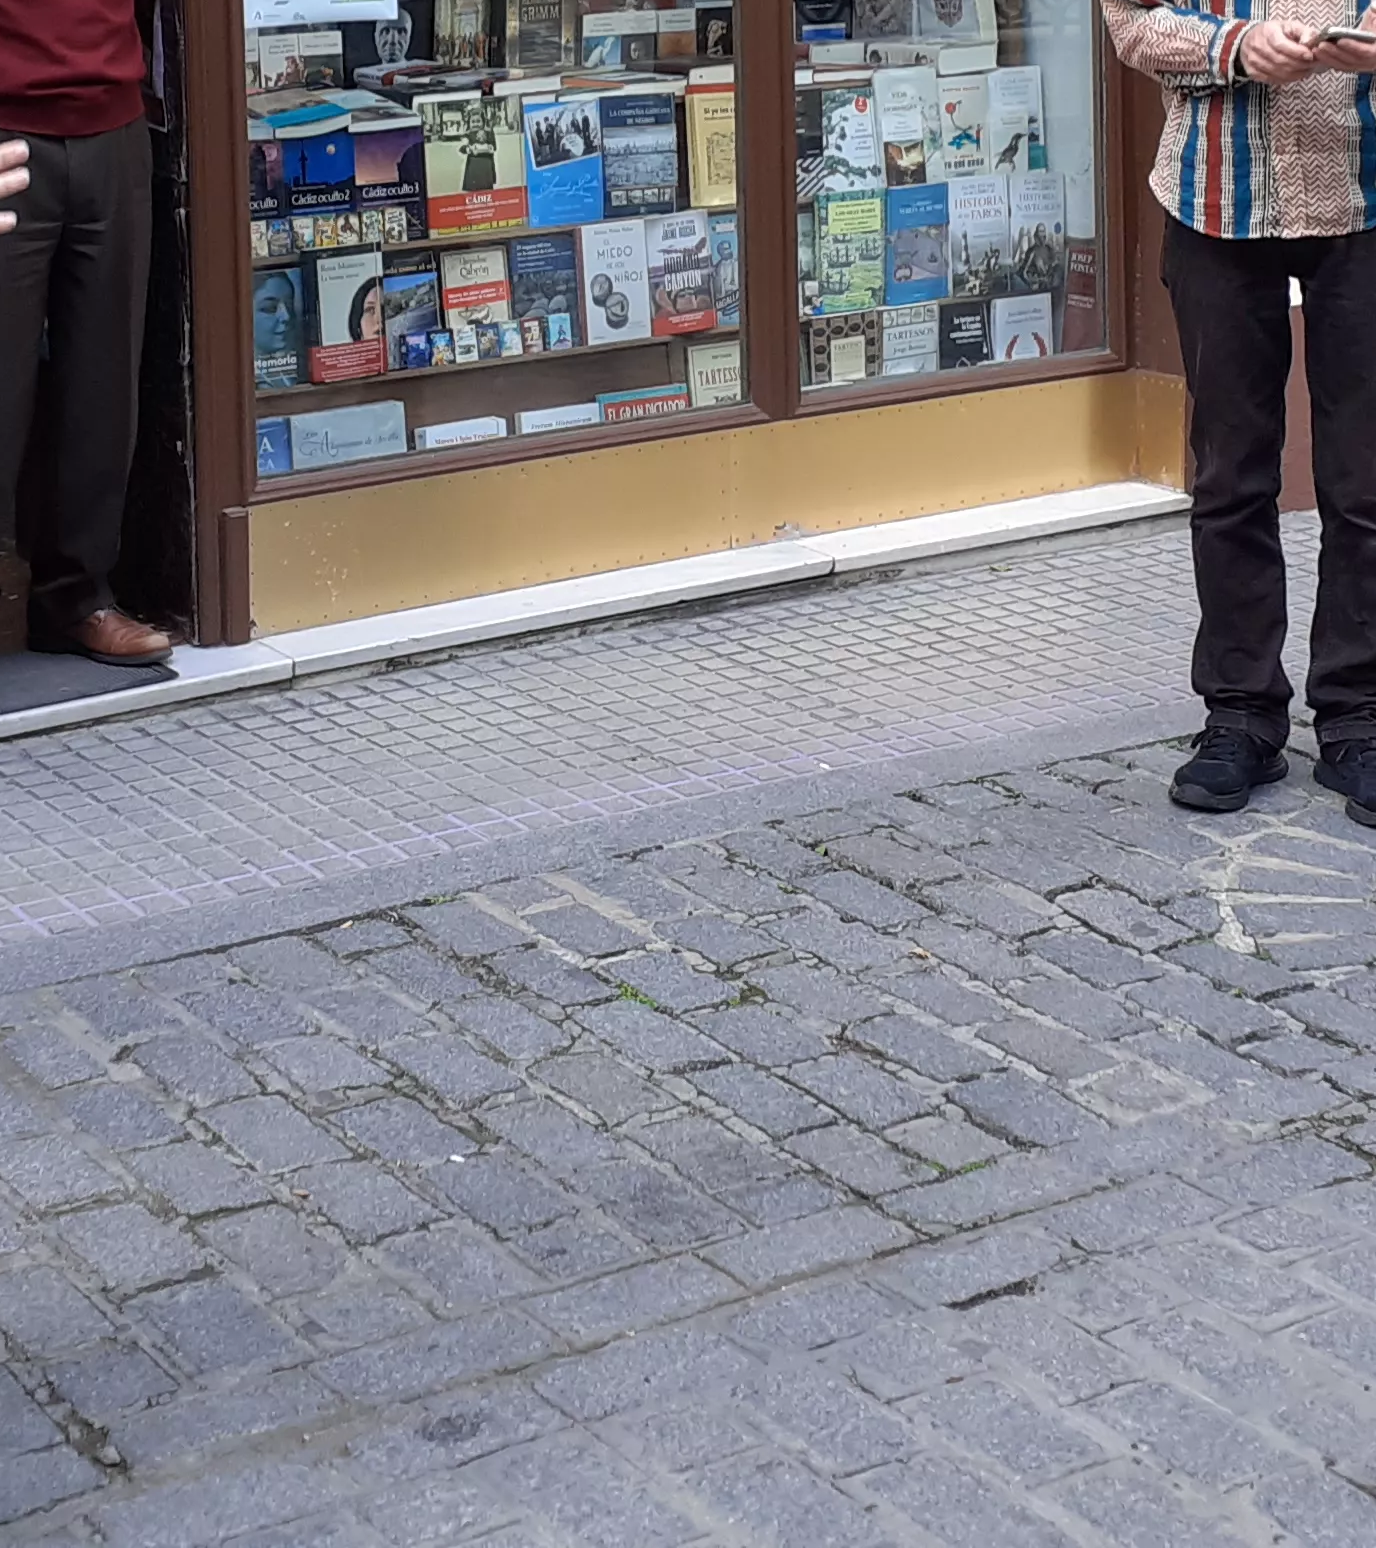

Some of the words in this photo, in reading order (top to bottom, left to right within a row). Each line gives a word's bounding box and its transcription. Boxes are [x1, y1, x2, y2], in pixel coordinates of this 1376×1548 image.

[521, 5, 561, 22] GRIMM
[344, 188, 351, 201] 2
[597, 245, 633, 260] MIEDO
[614, 268, 644, 284] NIÑOS
